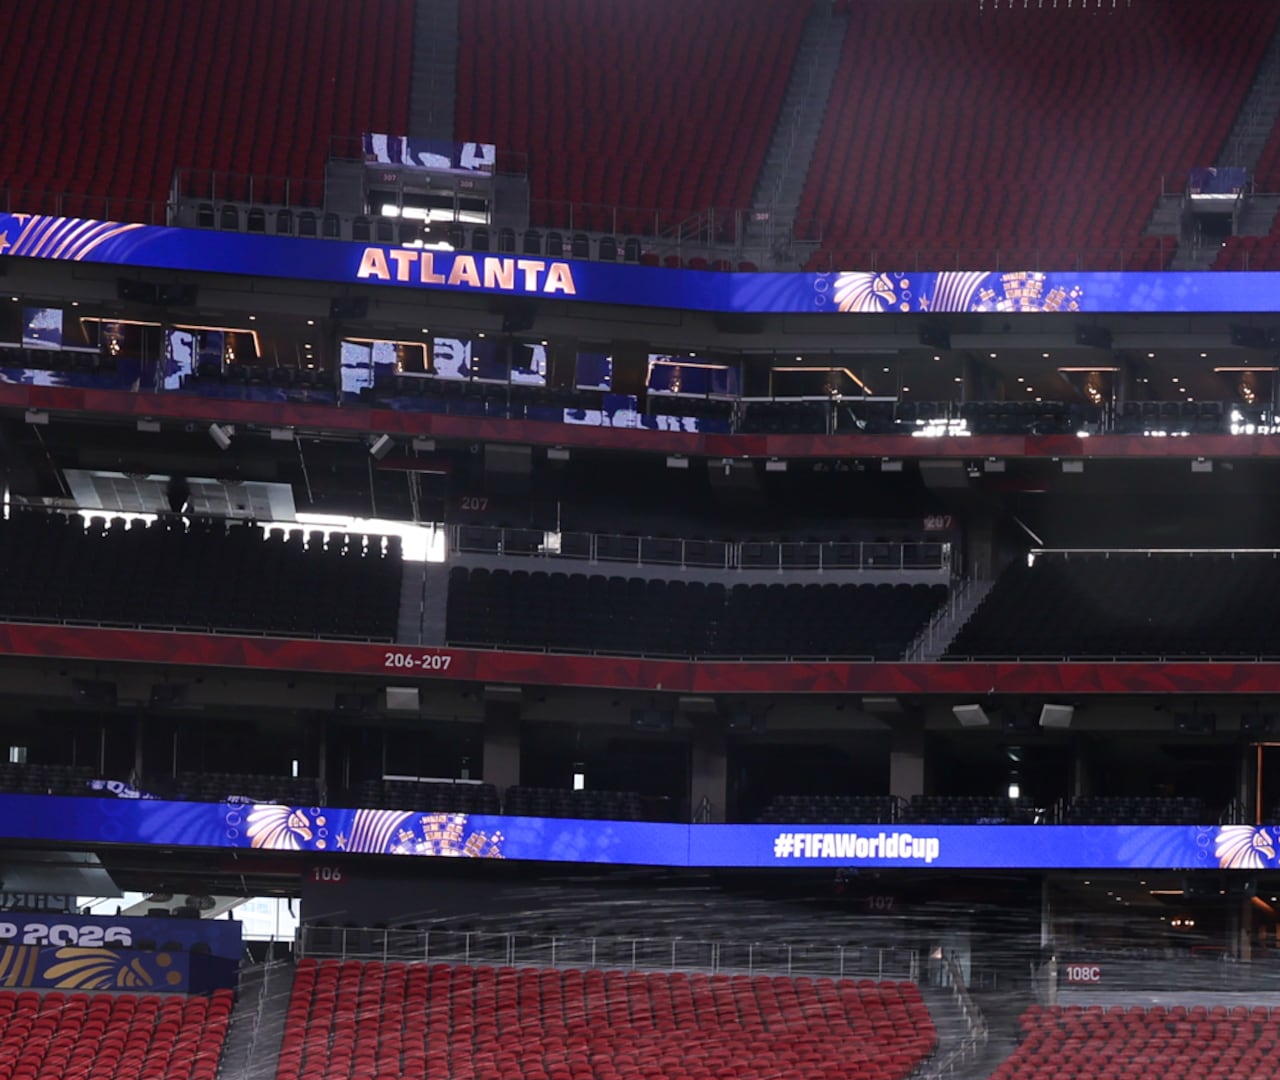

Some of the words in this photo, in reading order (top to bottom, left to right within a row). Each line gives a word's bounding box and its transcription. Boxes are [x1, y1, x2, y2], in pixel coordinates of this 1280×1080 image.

[357, 247, 576, 294] ATLANTA
[462, 496, 489, 511] 207
[927, 515, 952, 529] 207
[384, 653, 452, 670] 206-207
[774, 832, 939, 863] #FIFAWorldCup
[312, 866, 342, 881] 106
[867, 895, 896, 910] 107
[23, 924, 132, 947] 2026
[1066, 967, 1101, 981] 108C
